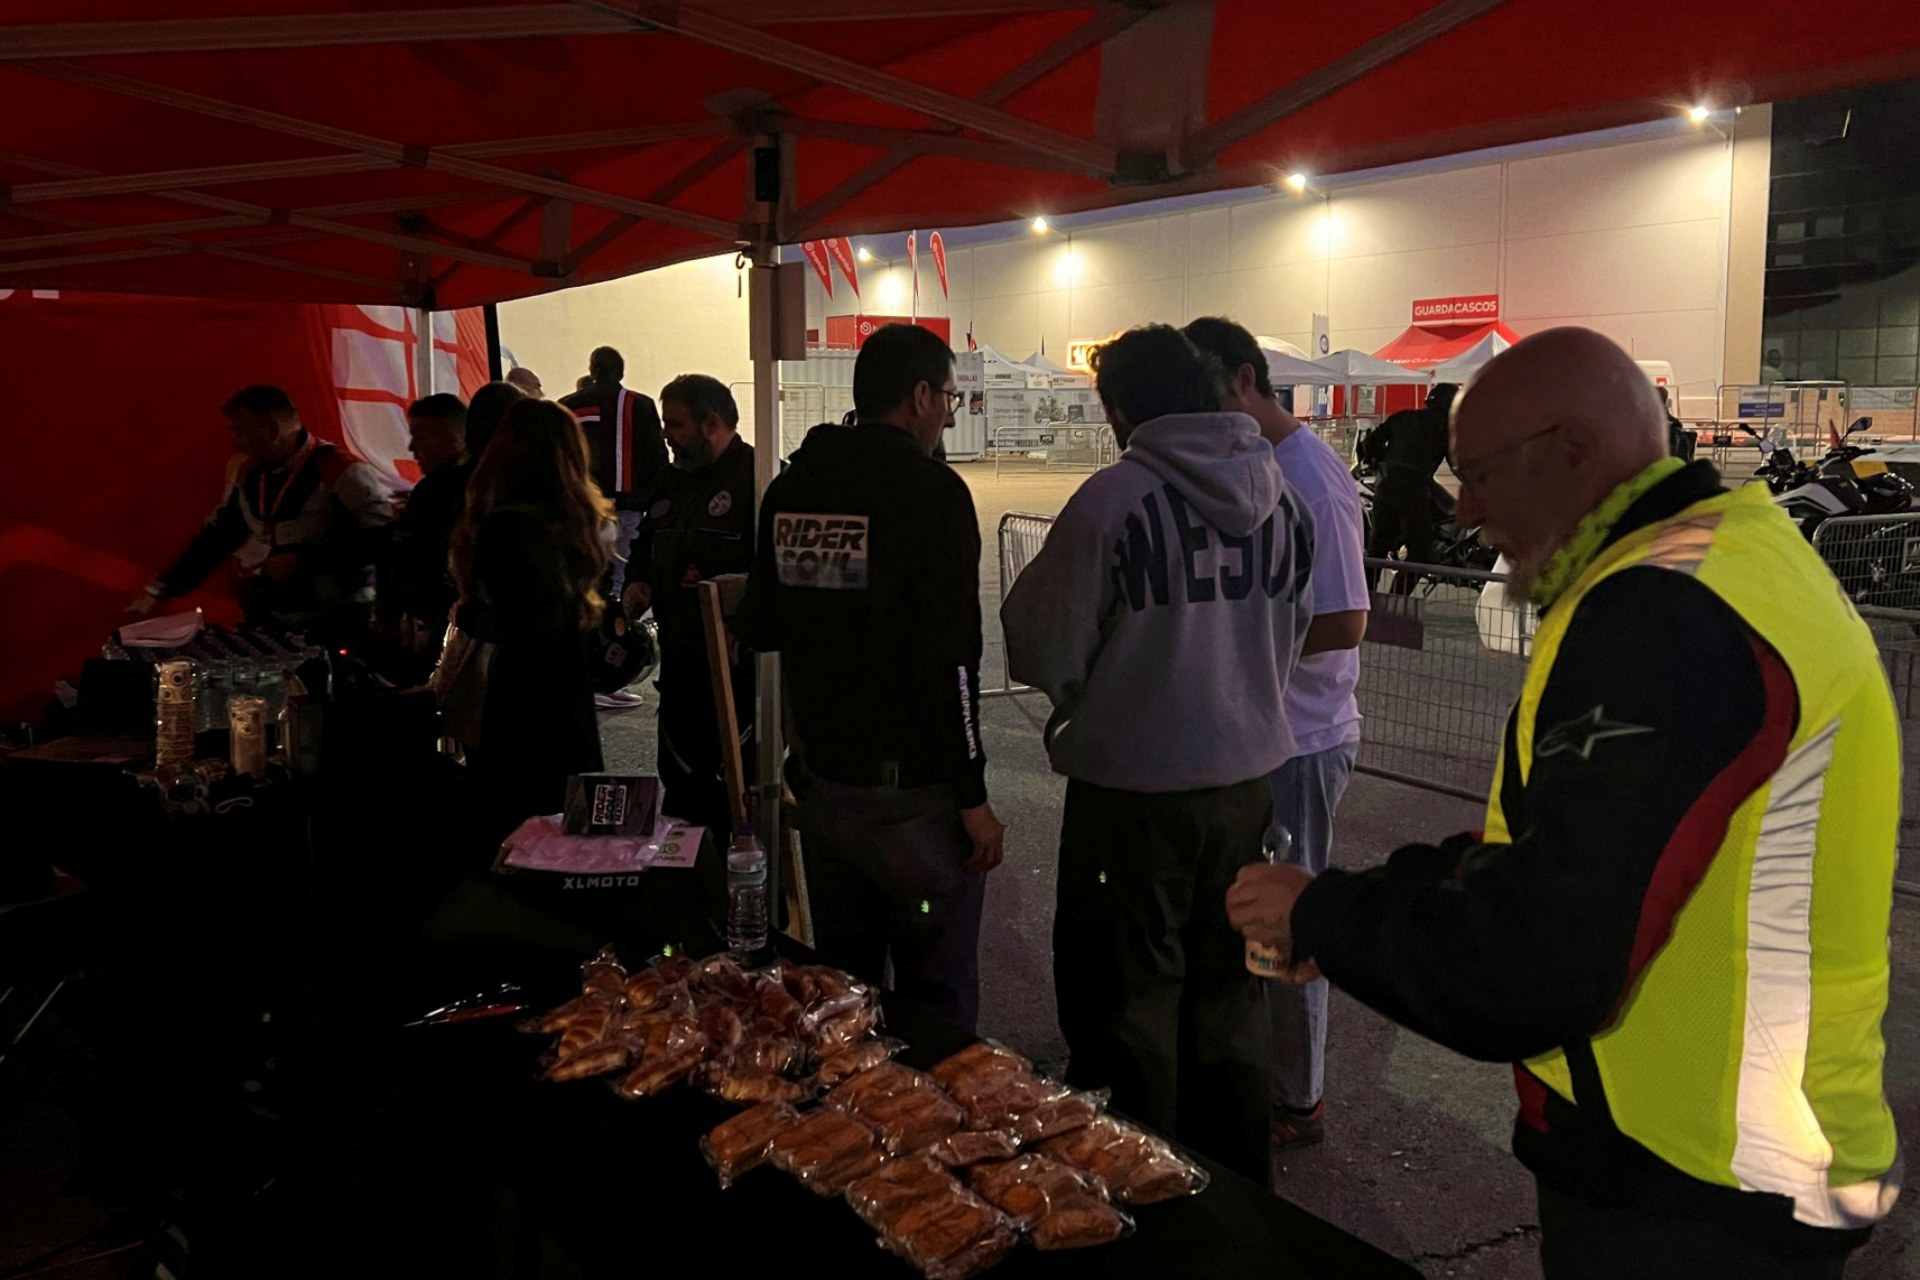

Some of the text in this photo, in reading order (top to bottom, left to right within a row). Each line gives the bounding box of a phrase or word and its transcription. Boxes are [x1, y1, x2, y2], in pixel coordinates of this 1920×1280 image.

[1414, 301, 1497, 316] GUARDACASCOS
[777, 518, 866, 551] RIDER
[594, 786, 607, 823] RIDER
[562, 875, 640, 890] XLMOTO
